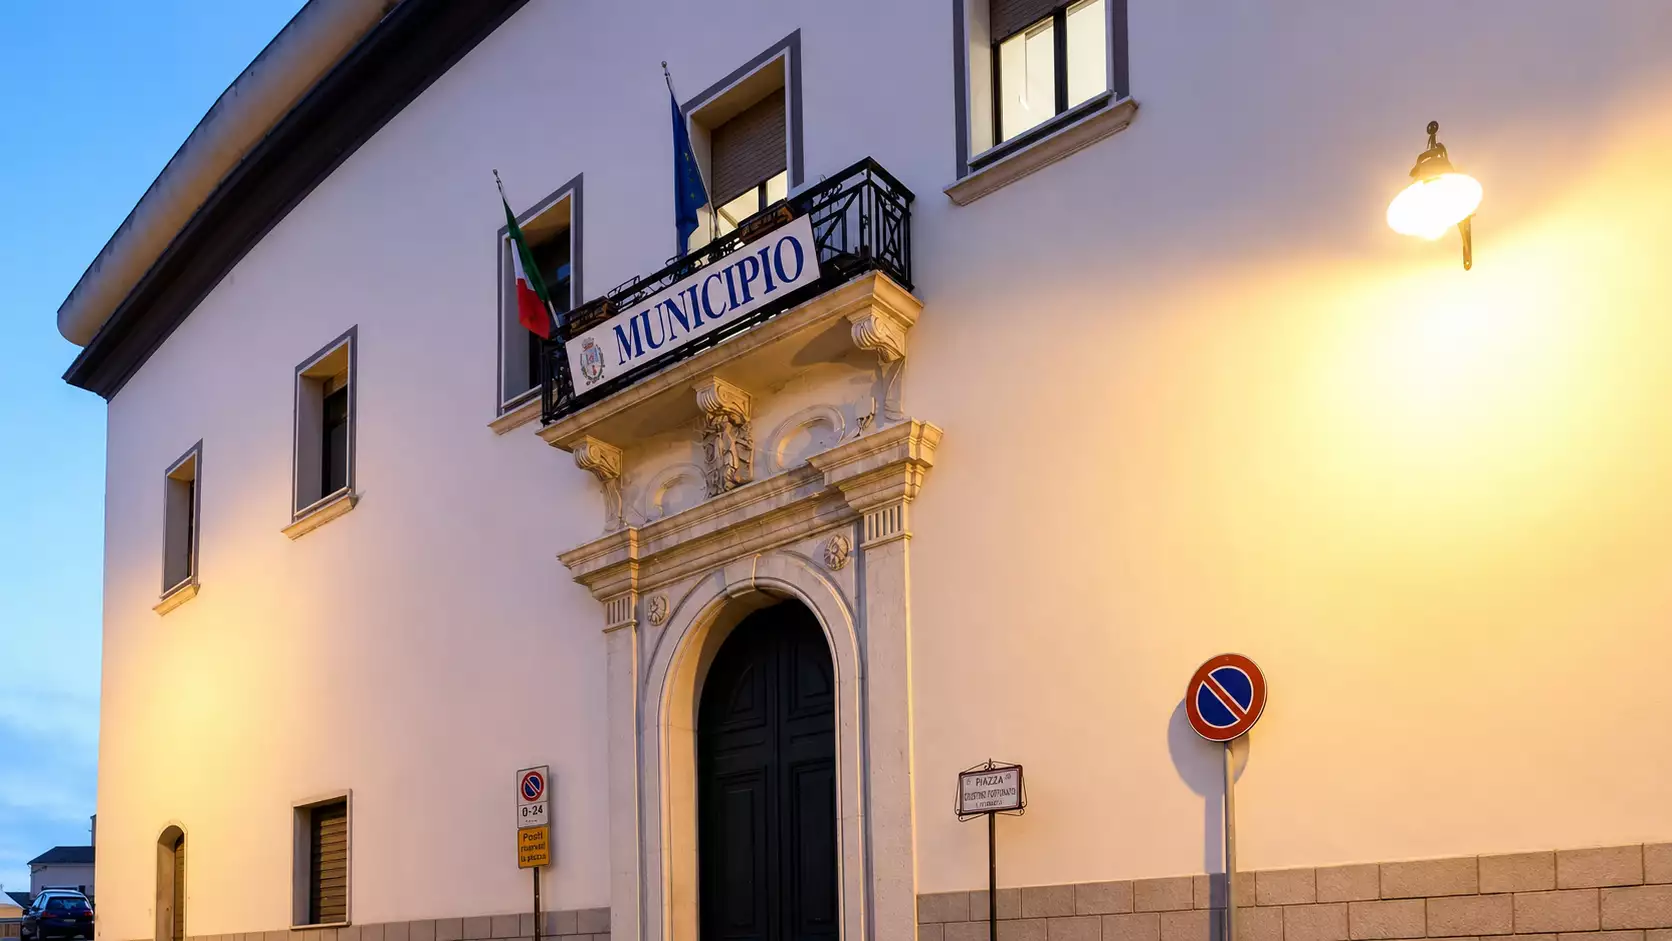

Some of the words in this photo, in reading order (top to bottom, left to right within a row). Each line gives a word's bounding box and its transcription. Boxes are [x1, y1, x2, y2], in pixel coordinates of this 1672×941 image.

[612, 235, 804, 366] MUNICIPIO
[975, 775, 1004, 786] PIAZZA
[522, 804, 543, 817] 0-24
